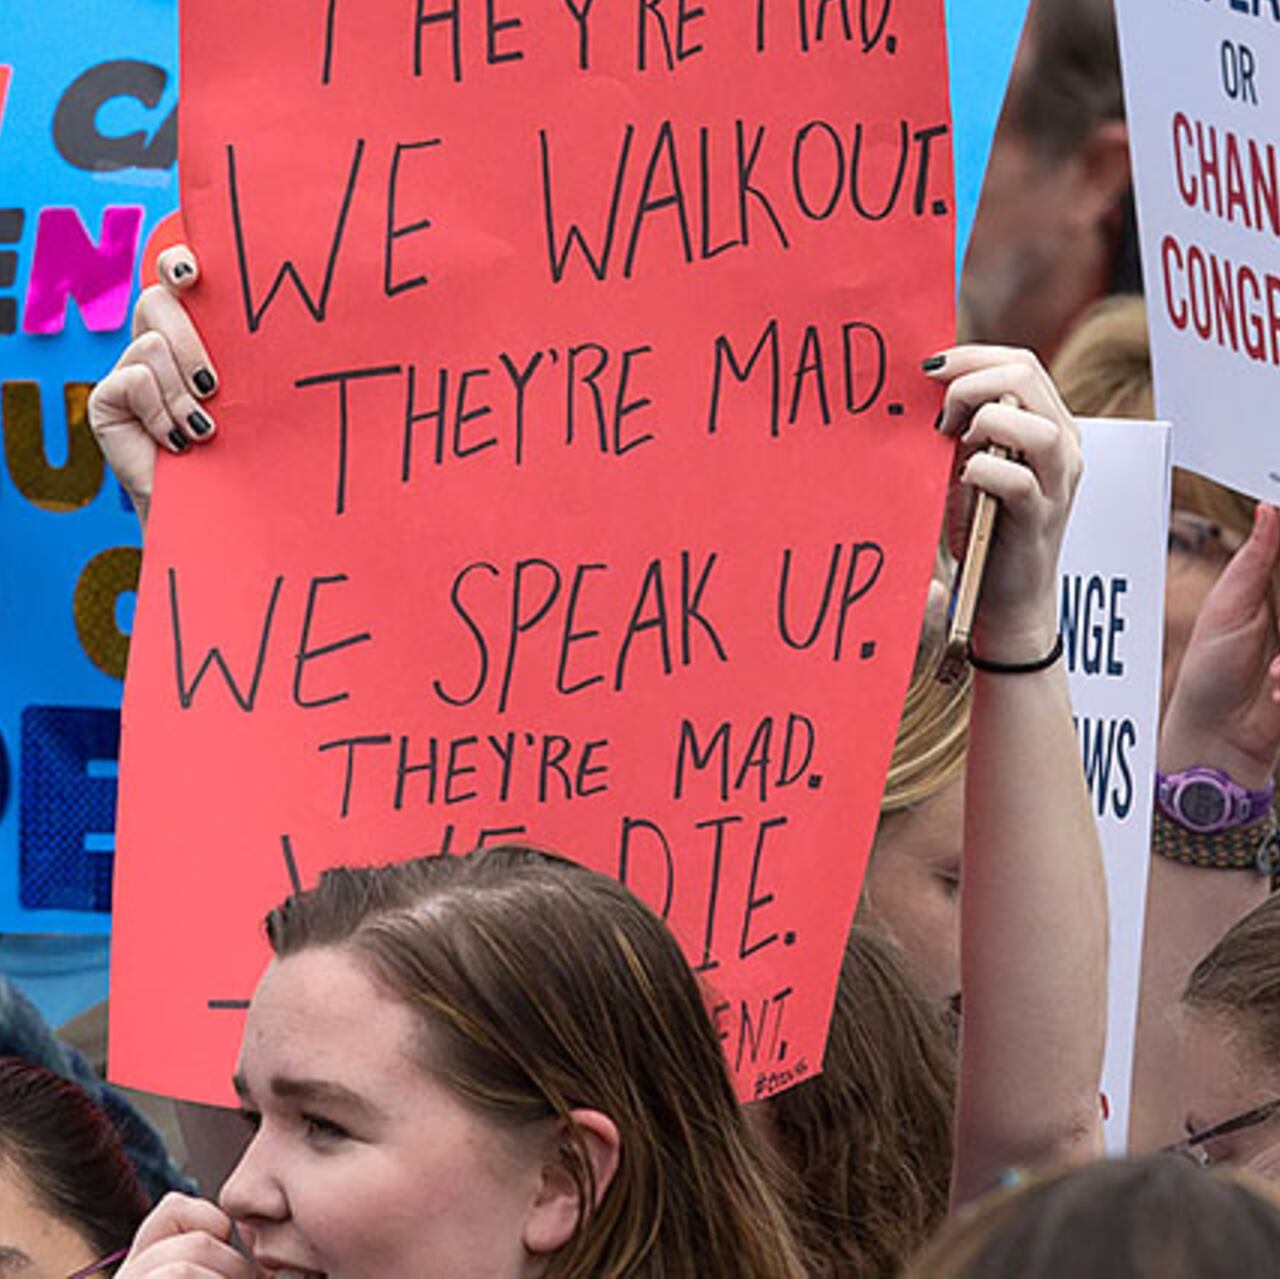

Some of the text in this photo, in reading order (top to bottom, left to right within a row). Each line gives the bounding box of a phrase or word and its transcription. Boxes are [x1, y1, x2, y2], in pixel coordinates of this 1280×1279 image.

[51, 58, 179, 173] C
[1220, 38, 1260, 108] OR
[226, 118, 950, 333] WE WALKOUT.
[294, 319, 906, 516] THEY'RE MAD.
[167, 540, 887, 715] WE SPEAK UP.
[318, 712, 824, 819] THEY'RE MAD.
[616, 814, 798, 973] DIE.
